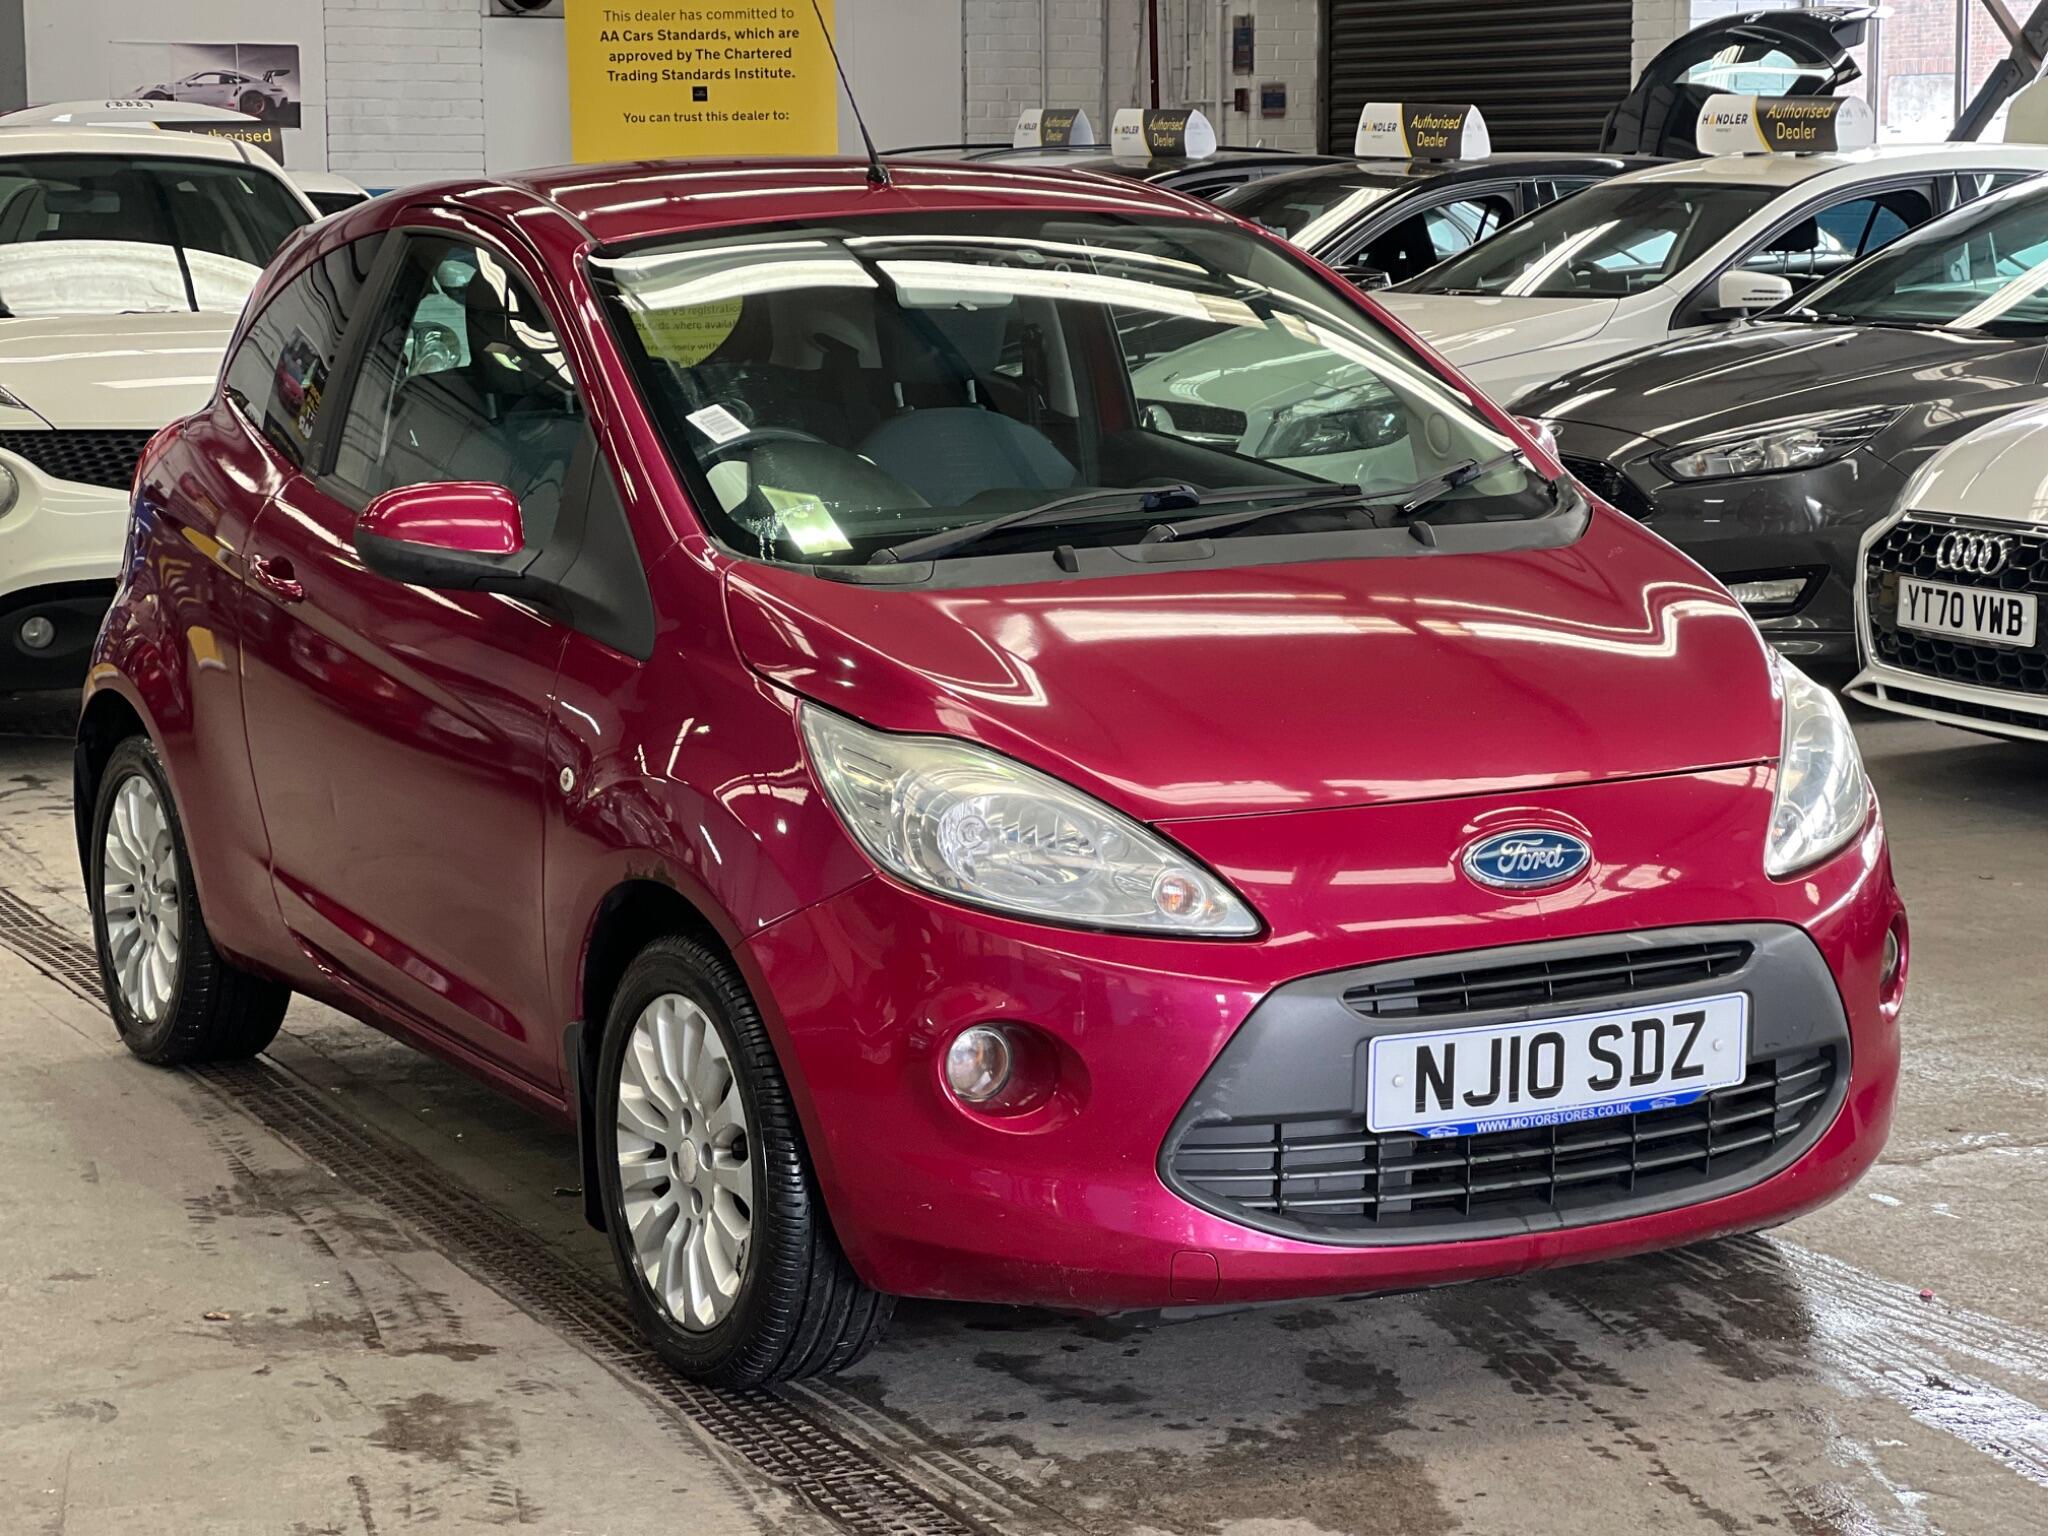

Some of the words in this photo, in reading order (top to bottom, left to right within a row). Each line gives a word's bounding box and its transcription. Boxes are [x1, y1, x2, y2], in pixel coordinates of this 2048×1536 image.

[603, 9, 631, 22] This
[634, 9, 676, 21] dealer
[679, 9, 702, 20] has
[706, 7, 777, 20] committed
[781, 7, 794, 19] to
[600, 30, 619, 42] AA
[623, 29, 654, 41] Cars
[657, 28, 731, 41] Standards,
[734, 27, 774, 40] which
[778, 28, 799, 39] are
[608, 50, 673, 63] approved
[676, 48, 692, 63] by
[695, 48, 721, 61] The
[724, 47, 792, 60] Chartered
[607, 69, 658, 83] Trading
[661, 69, 731, 81] Standards
[734, 67, 796, 80] Institute.
[623, 112, 646, 124] You
[649, 113, 671, 123] can
[674, 112, 703, 122] trust
[706, 111, 728, 122] this
[731, 110, 770, 121] dealer
[773, 110, 790, 121] to:
[1766, 102, 1834, 119] Authorised
[1148, 114, 1186, 131] Authorised
[1411, 113, 1463, 129] Authorised
[1702, 113, 1748, 126] HANDLER
[189, 128, 272, 142] thorised
[1416, 131, 1449, 147] Dealer
[1776, 122, 1817, 140] Dealer
[1153, 132, 1176, 147] Dealer
[1908, 584, 1964, 629] YT70
[1973, 593, 2023, 637] VWB
[1497, 838, 1564, 873] Ford
[1414, 1031, 1566, 1114] NJ10
[1587, 1010, 1706, 1092] SDZ
[1476, 1103, 1632, 1133] WWW.MOTORSTORES.CO.UK
